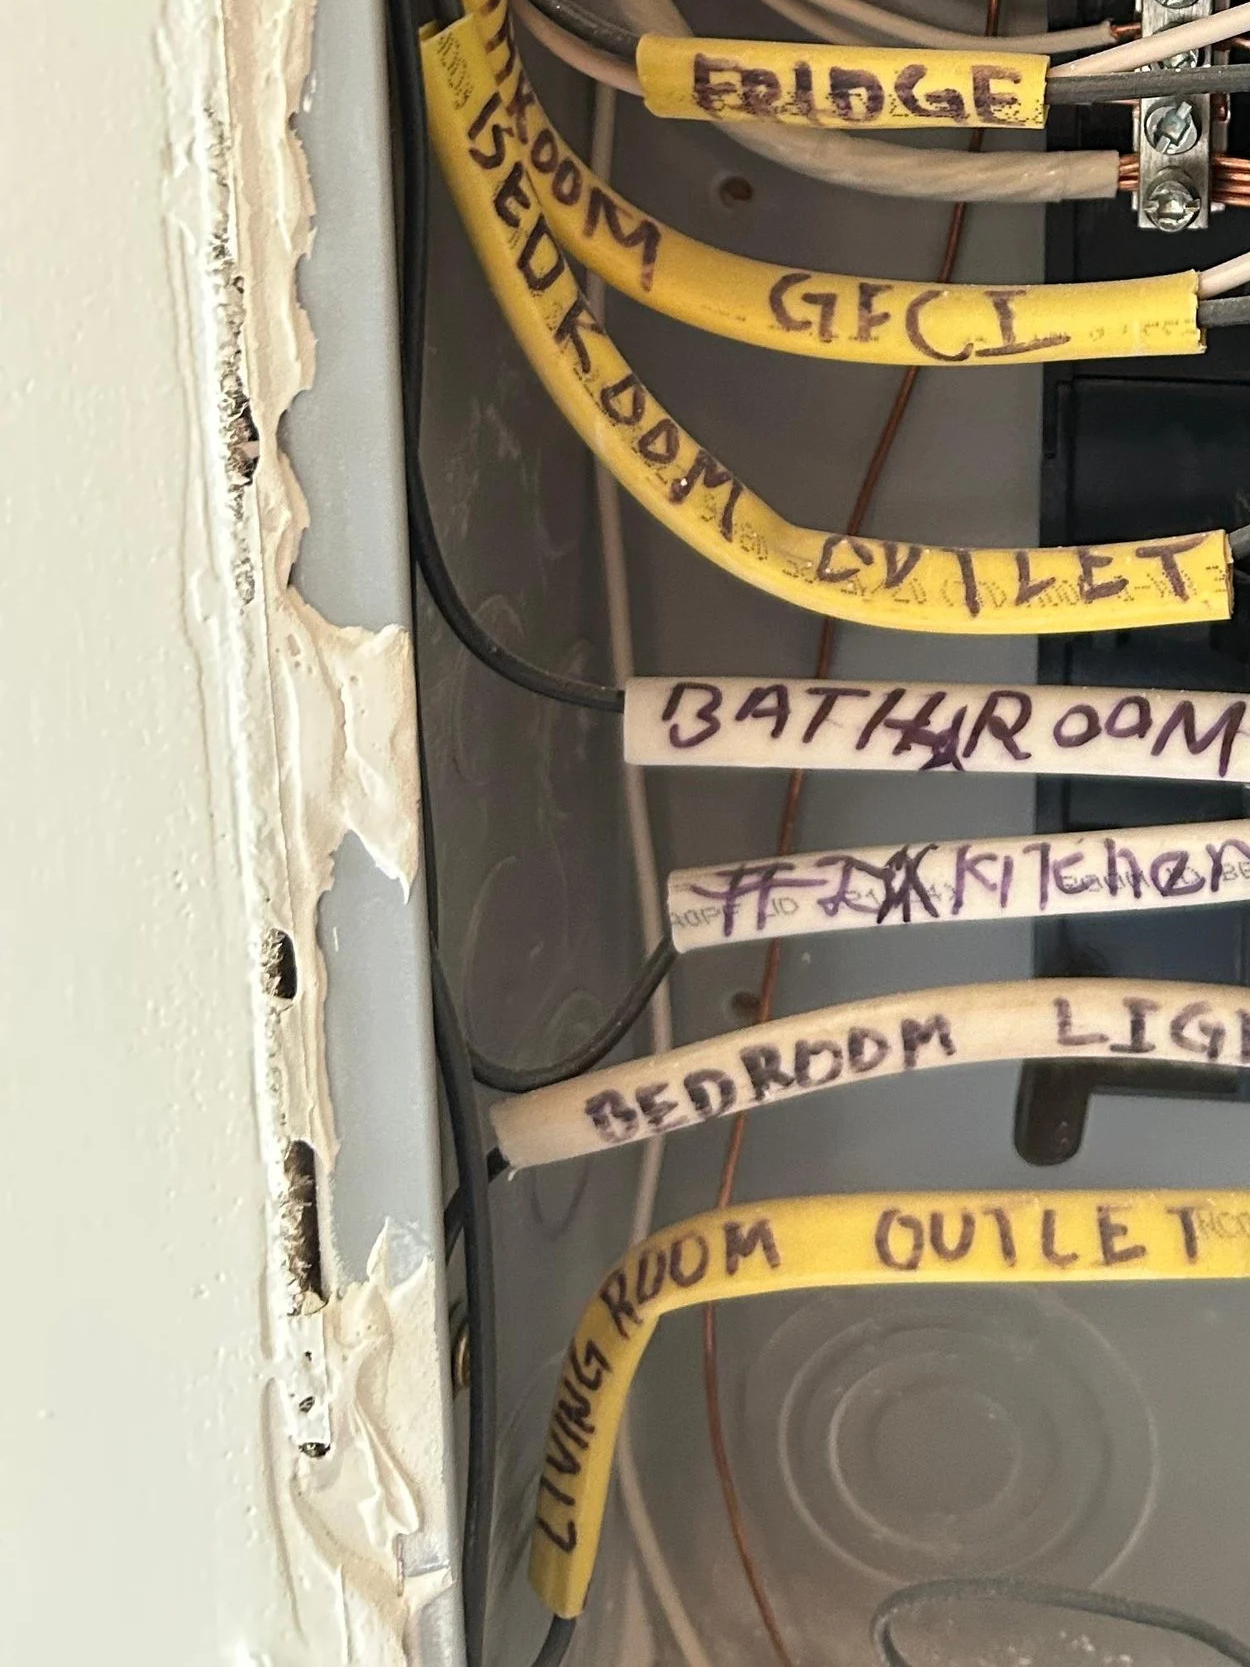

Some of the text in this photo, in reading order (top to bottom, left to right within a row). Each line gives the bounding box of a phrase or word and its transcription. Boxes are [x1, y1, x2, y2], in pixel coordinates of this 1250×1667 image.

[692, 52, 1027, 129] FRIDGE
[768, 272, 1071, 363] GFCI
[583, 1011, 958, 1147] BEDROOM
[536, 1203, 1206, 1557] LIVING ROOM OUTLET
